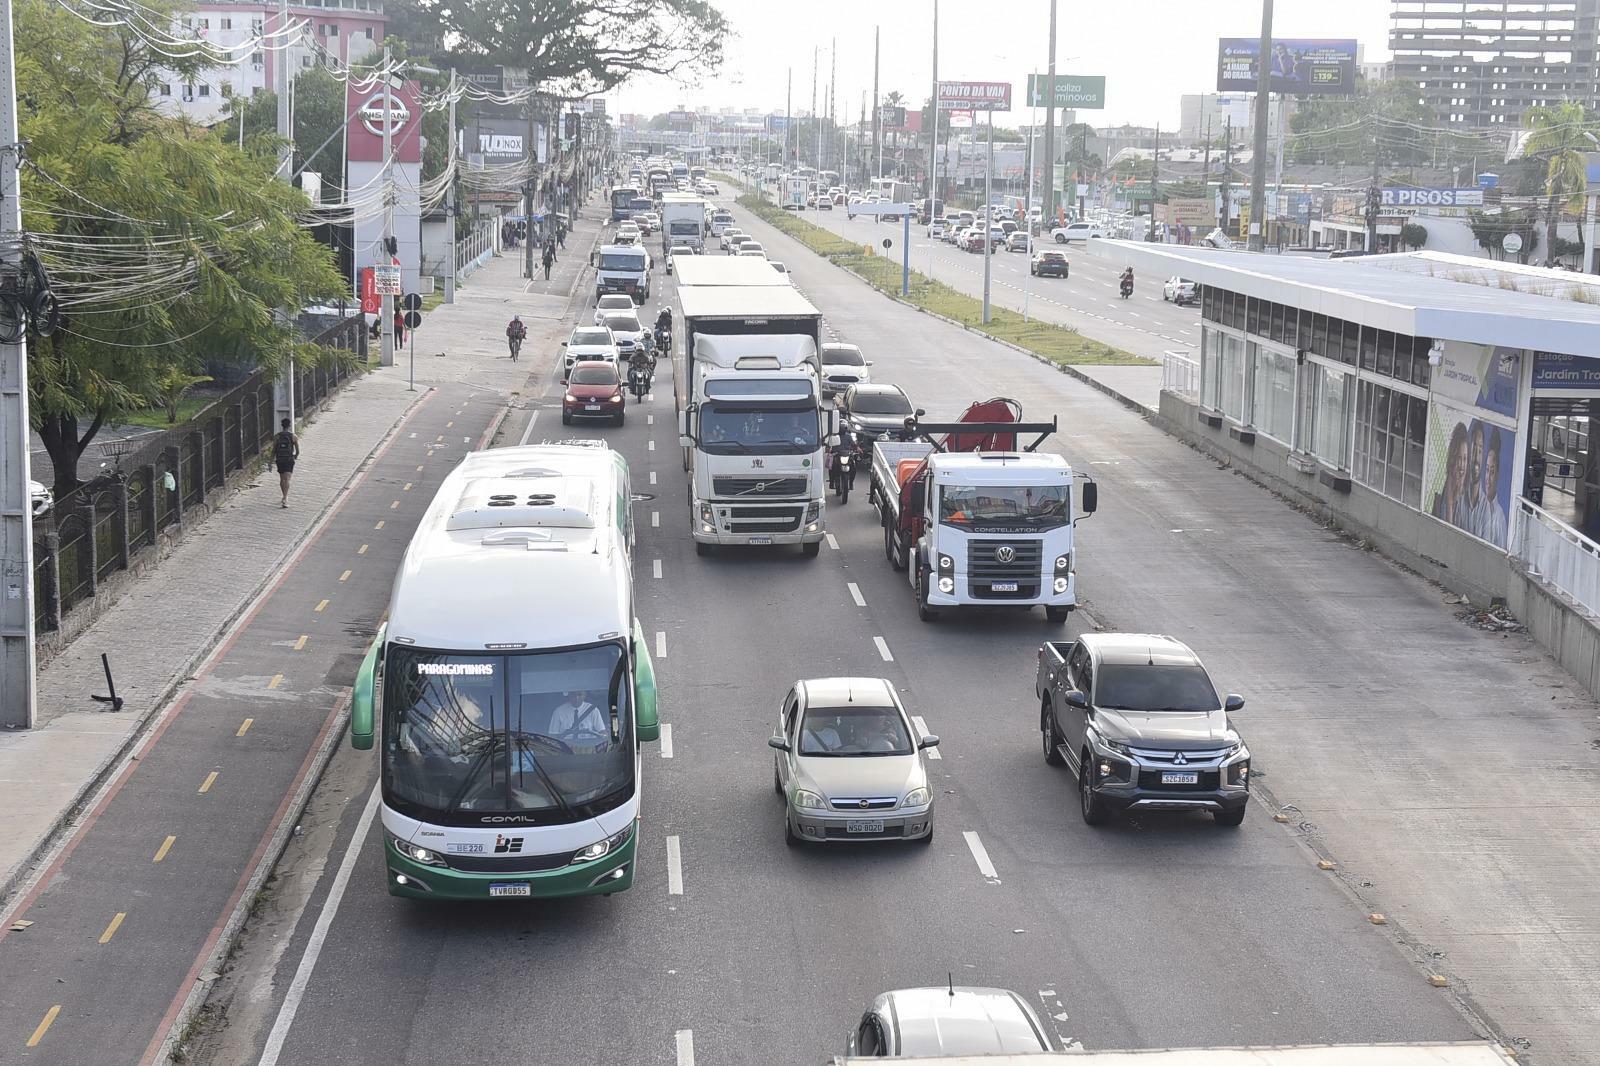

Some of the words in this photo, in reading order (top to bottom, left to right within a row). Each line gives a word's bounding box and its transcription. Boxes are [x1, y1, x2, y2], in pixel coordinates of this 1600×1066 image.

[940, 85, 970, 97] PONTO
[971, 86, 985, 97] DA
[986, 86, 1005, 98] VAN
[1055, 83, 1081, 93] caliza
[1056, 93, 1097, 102] minovos
[363, 111, 405, 120] NISAN
[1382, 190, 1394, 205] R
[1398, 190, 1454, 205] PISOS
[1537, 368, 1579, 380] Jardim
